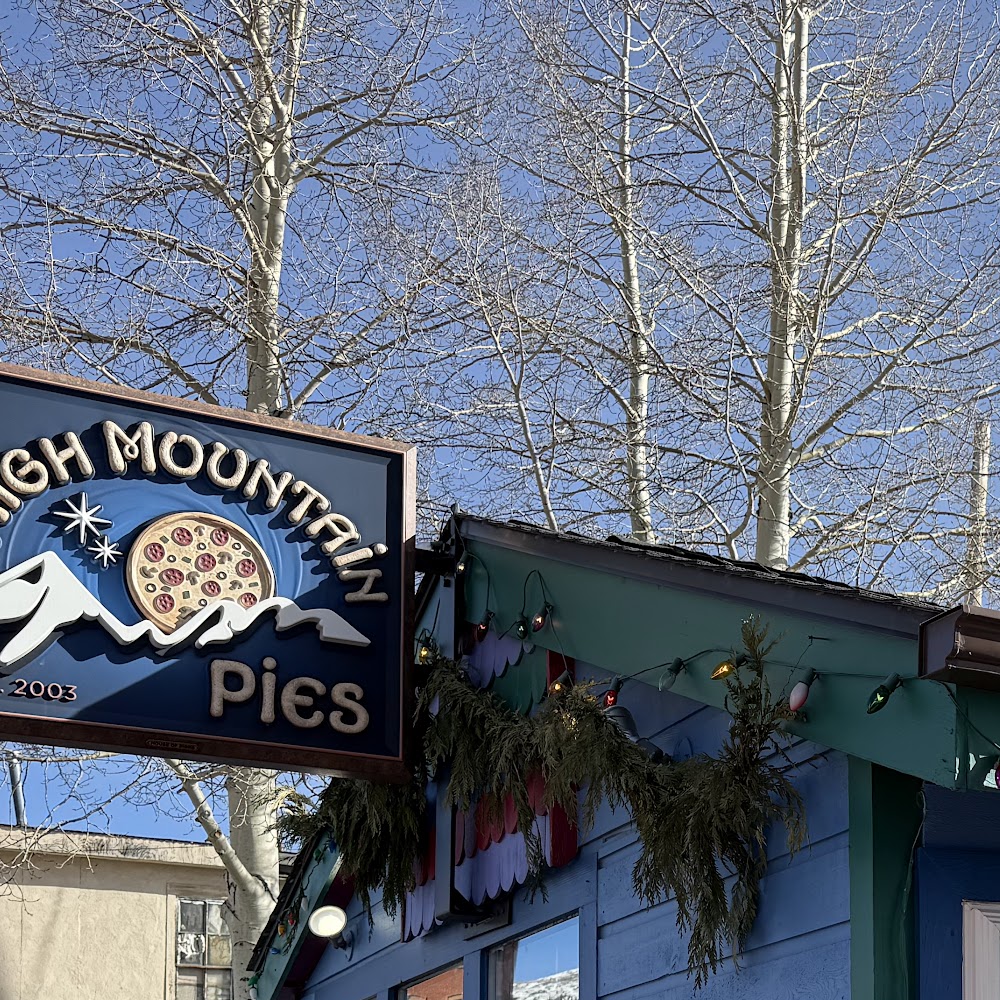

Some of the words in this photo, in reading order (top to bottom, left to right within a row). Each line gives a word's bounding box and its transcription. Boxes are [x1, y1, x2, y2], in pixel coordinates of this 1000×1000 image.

[0, 431, 94, 523] IGH
[13, 678, 78, 702] 2003
[209, 656, 371, 734] Pies
